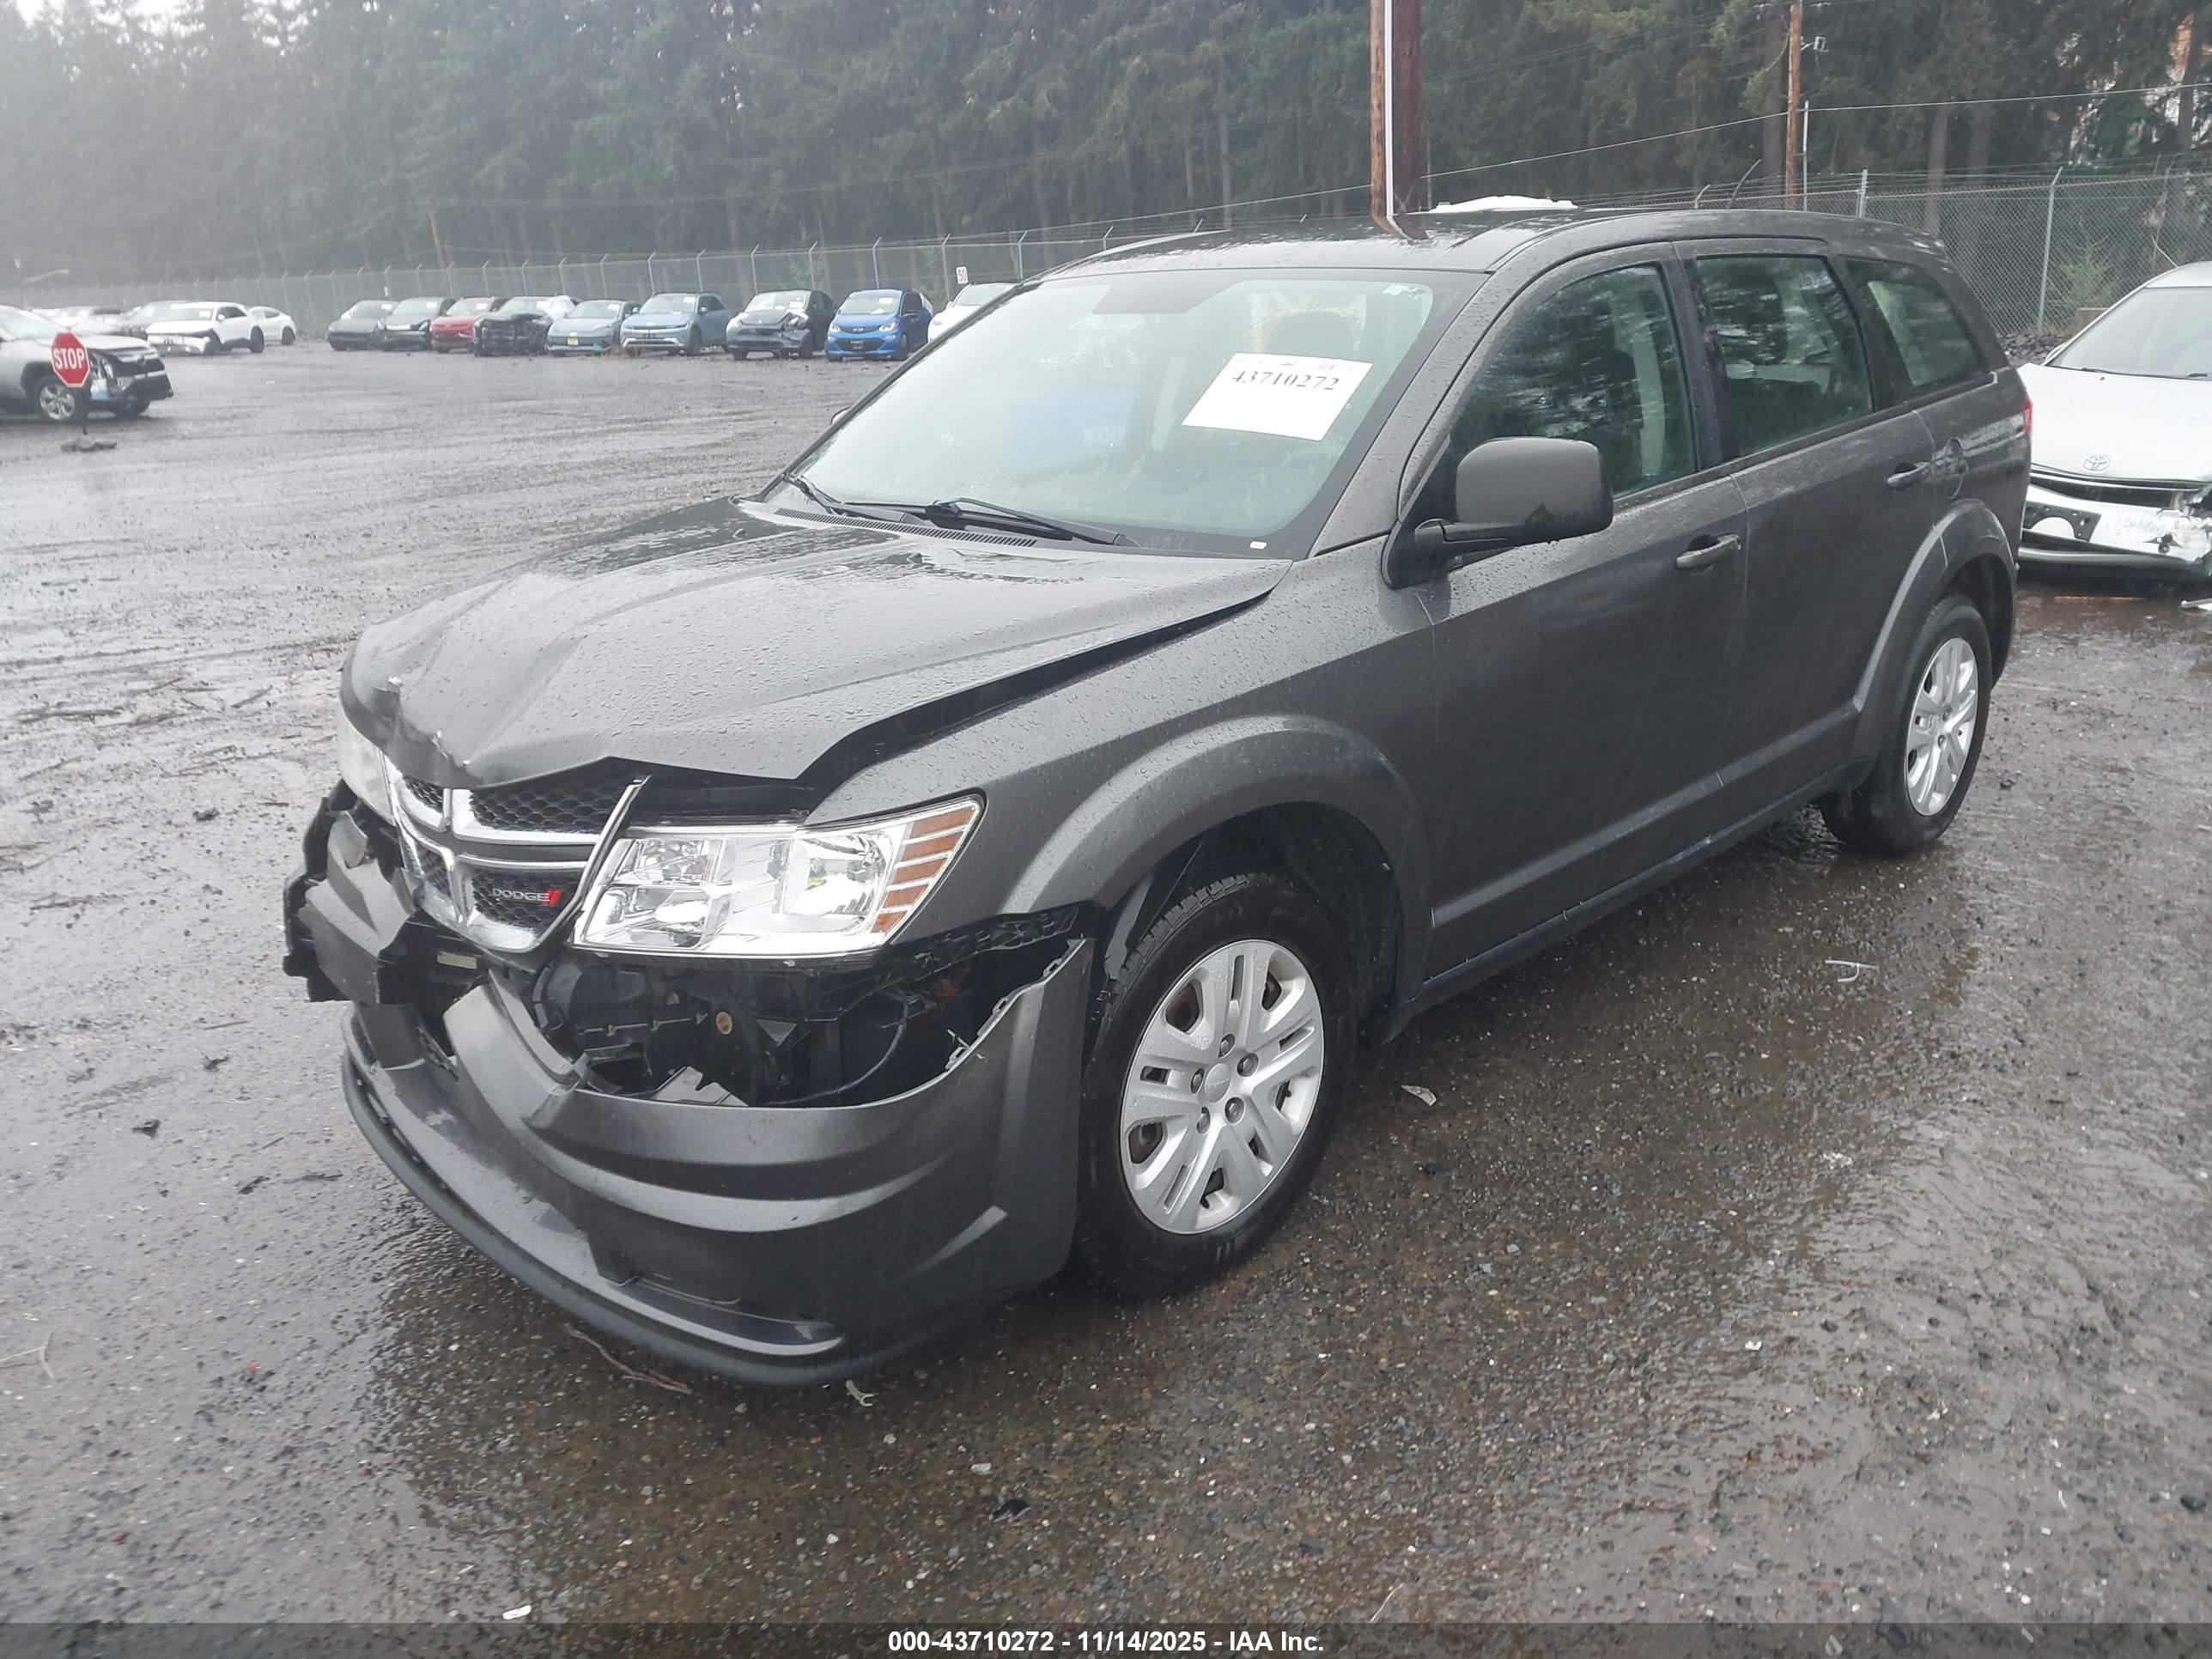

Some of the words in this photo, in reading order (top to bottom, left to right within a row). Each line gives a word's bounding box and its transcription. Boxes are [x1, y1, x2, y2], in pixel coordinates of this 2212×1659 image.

[53, 347, 85, 370] STOP
[1231, 370, 1340, 391] 43710272
[492, 888, 550, 902] DODGE
